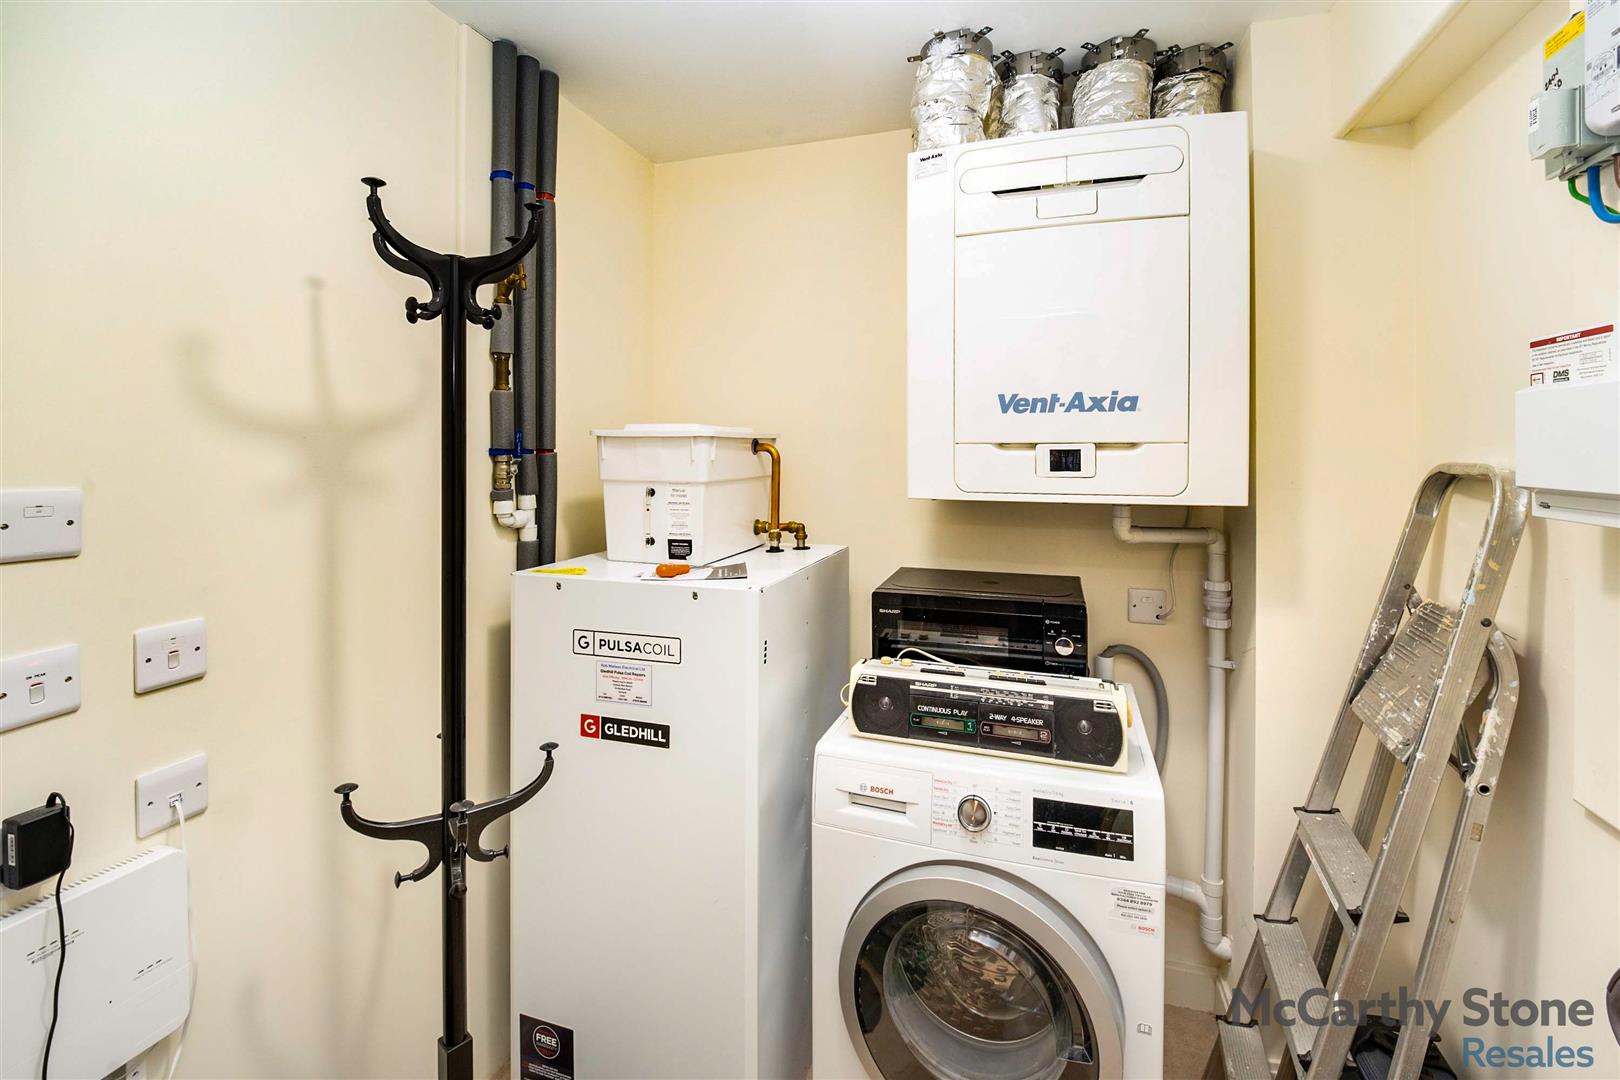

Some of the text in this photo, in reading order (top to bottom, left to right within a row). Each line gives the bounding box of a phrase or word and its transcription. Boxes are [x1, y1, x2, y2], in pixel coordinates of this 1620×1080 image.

[919, 153, 943, 162] Vent-Axia
[1556, 332, 1581, 341] IMPORTANT
[1553, 369, 1570, 379] DMS
[998, 391, 1139, 414] Vent-Axia
[578, 635, 675, 657] G PULSACOIL
[917, 705, 951, 715] CONTINUOUS
[989, 713, 1043, 726] 2-WAY 4-SPEAKER
[584, 719, 667, 742] G GLEDHILL
[870, 786, 894, 795] BOSCH
[536, 1033, 557, 1047] FREE
